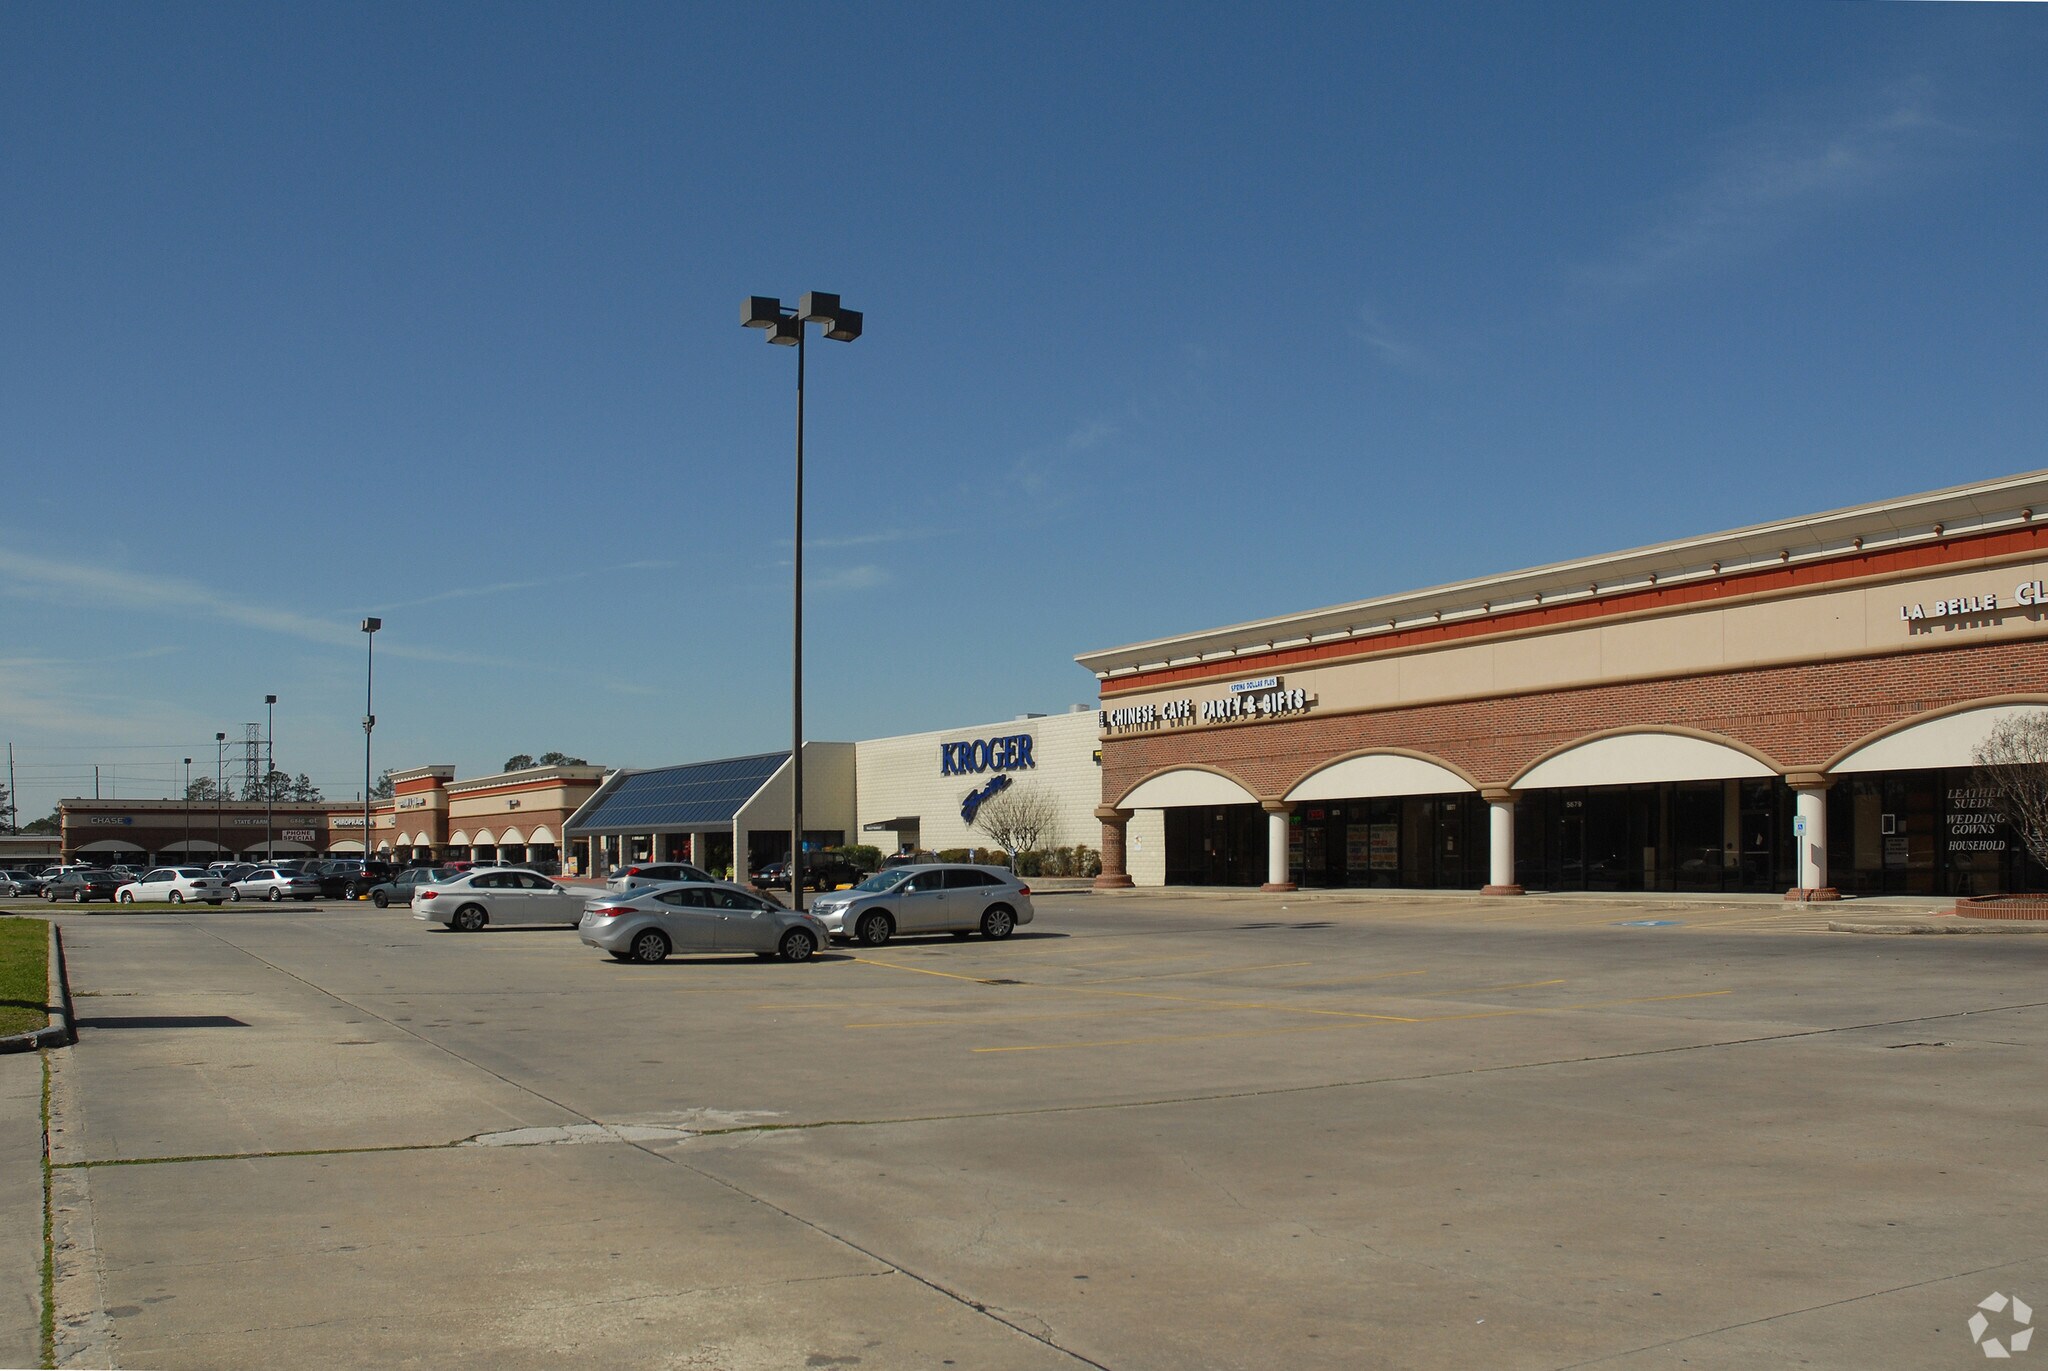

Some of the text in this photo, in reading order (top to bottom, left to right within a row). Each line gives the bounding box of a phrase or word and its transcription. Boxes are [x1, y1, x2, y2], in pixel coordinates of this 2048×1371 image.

[1900, 580, 2048, 620] LA BELLE CL
[1110, 703, 1156, 727] CHINESE
[1162, 699, 1192, 720] CAFE
[1201, 688, 1305, 719] PARTY & GIFTS
[941, 734, 1035, 776] KROGER
[91, 817, 123, 825] CHASE
[1946, 813, 2006, 824] WEDDING
[1951, 824, 1996, 835] GOWNS
[1948, 840, 2006, 851] HOUSEHOLD
